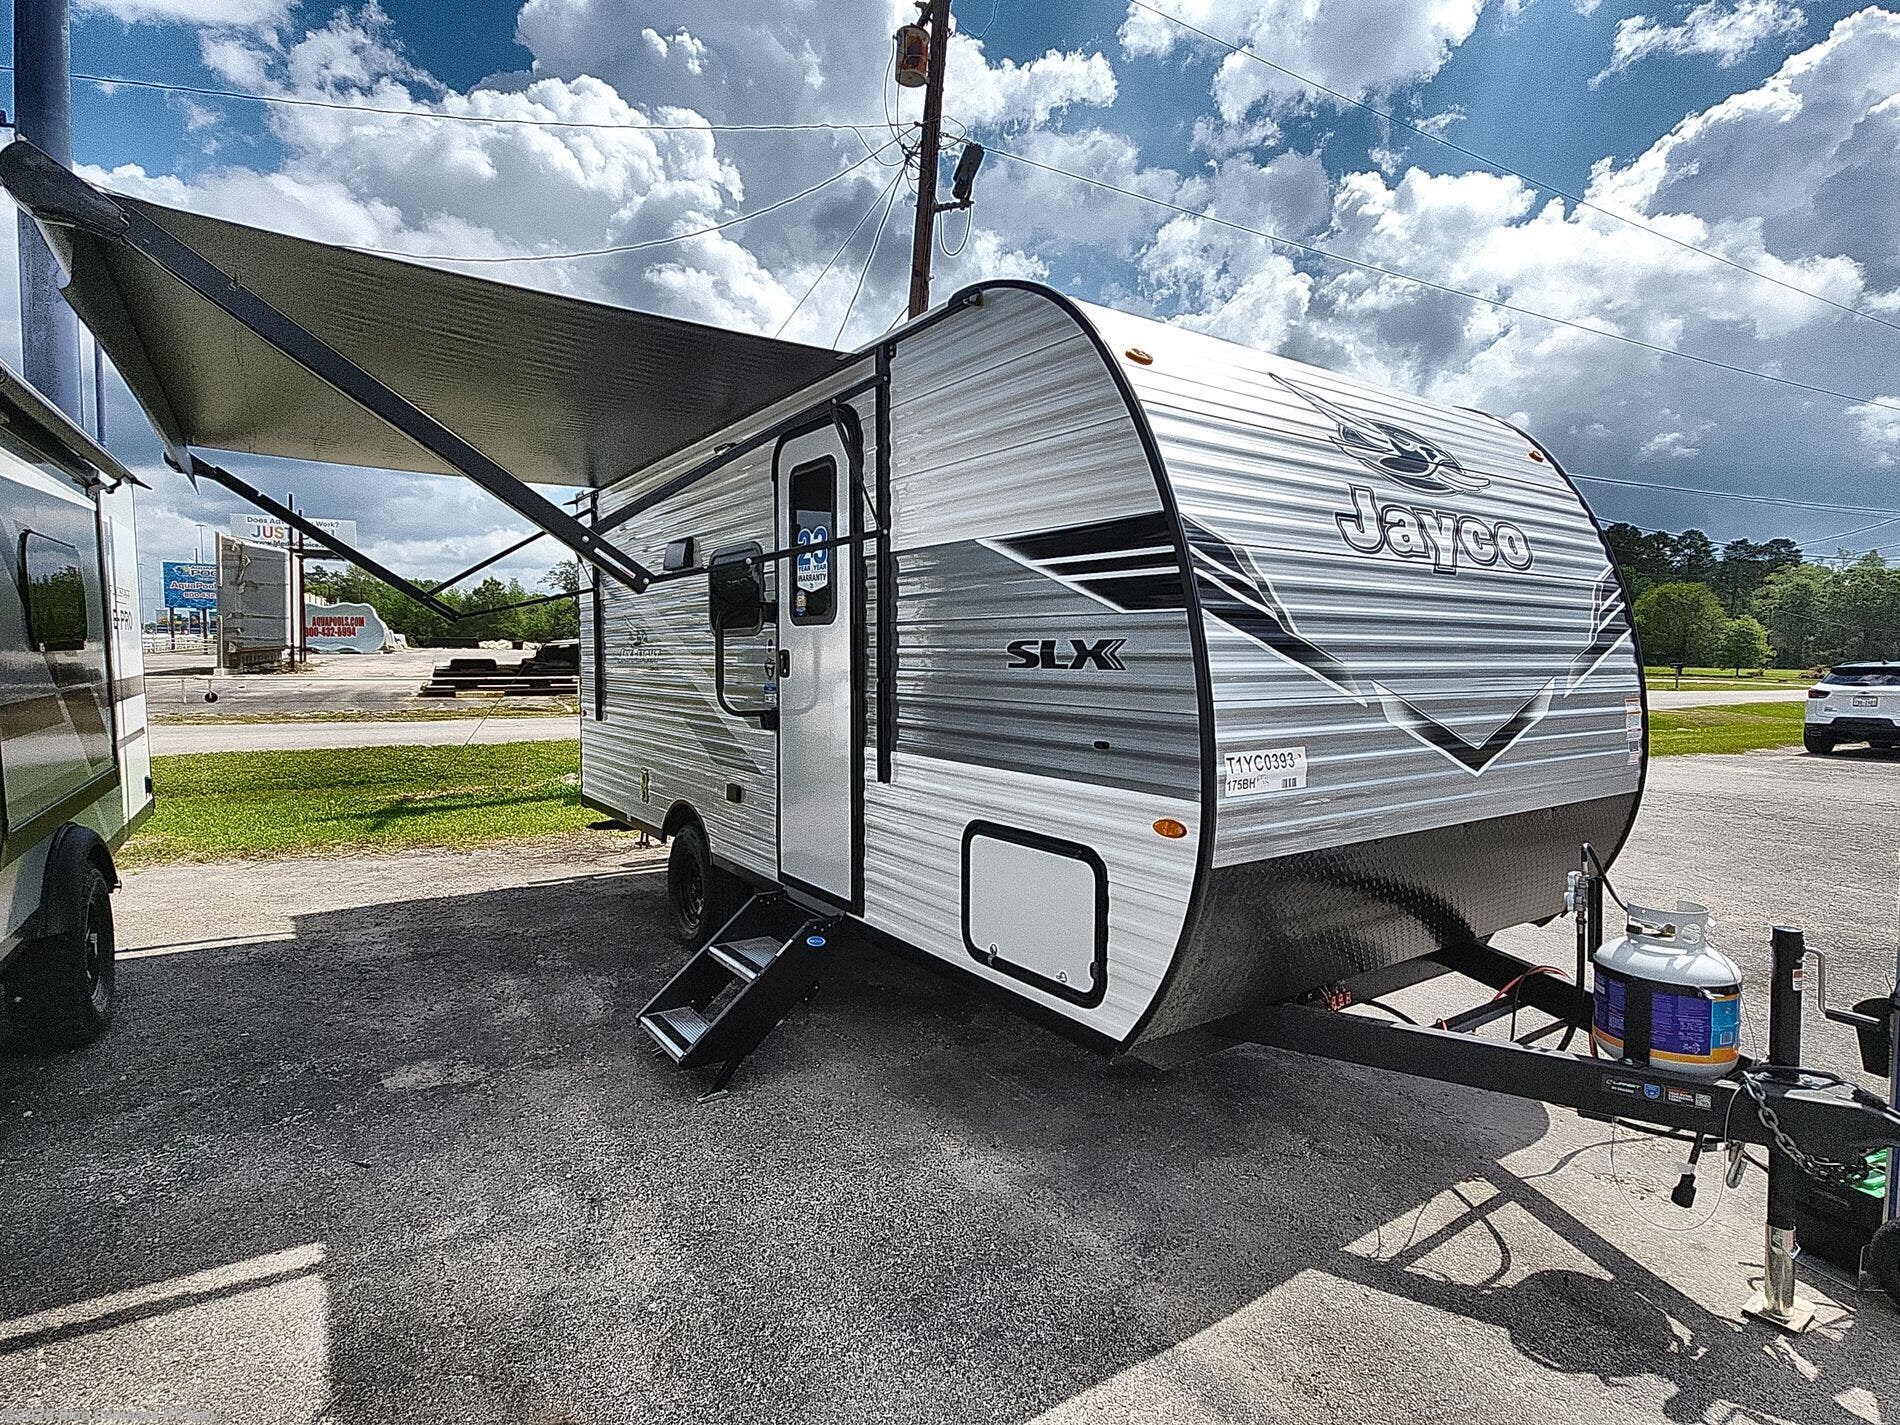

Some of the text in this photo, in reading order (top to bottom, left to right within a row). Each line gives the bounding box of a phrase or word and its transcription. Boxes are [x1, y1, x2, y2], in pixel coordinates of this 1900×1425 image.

[247, 516, 267, 525] Does
[315, 520, 340, 528] Work?
[1335, 482, 1534, 576] Jayco
[813, 563, 827, 571] YEAR
[798, 573, 827, 582] WARRANTY
[311, 616, 365, 627] AQUAPOOLS.COM
[1006, 639, 1128, 670] SLX
[1226, 752, 1296, 774] T1YC0393
[1227, 777, 1256, 791] 175BH
